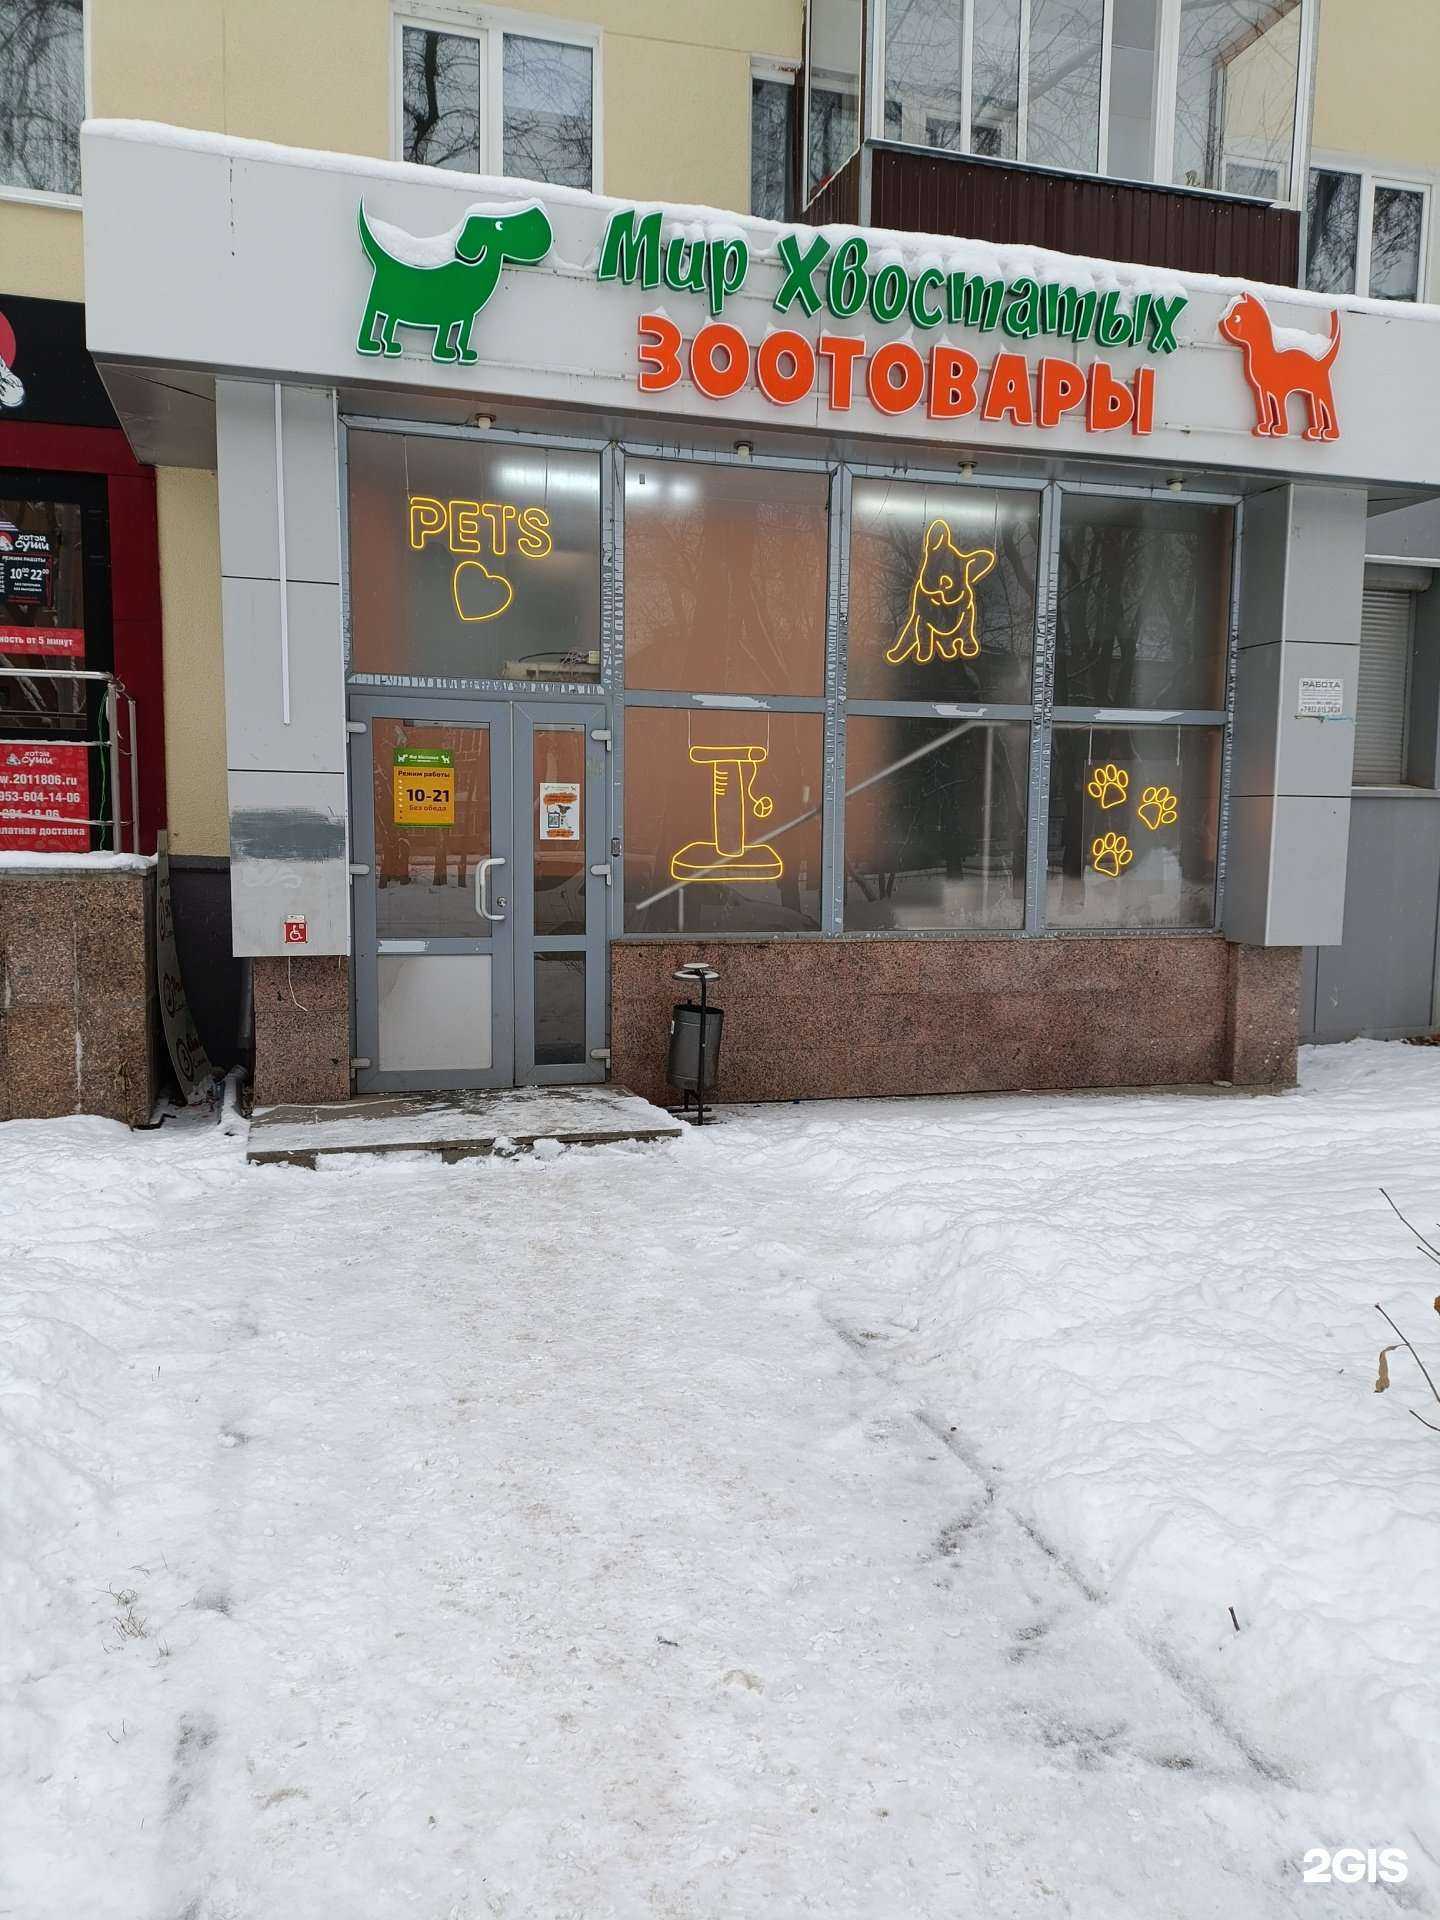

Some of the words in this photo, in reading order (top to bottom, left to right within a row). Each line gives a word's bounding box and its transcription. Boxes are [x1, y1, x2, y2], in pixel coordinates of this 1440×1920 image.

[597, 209, 749, 316] Мир
[772, 233, 1190, 355] Хвостатых
[638, 313, 1156, 436] ЗООТОВАРЫ
[409, 496, 552, 558] PETS
[38, 636, 44, 645] 5
[46, 638, 73, 647] минут
[1302, 681, 1341, 689] РАБОТА
[423, 771, 450, 779] работы
[406, 788, 449, 803] 10-21
[39, 828, 85, 836] доставка
